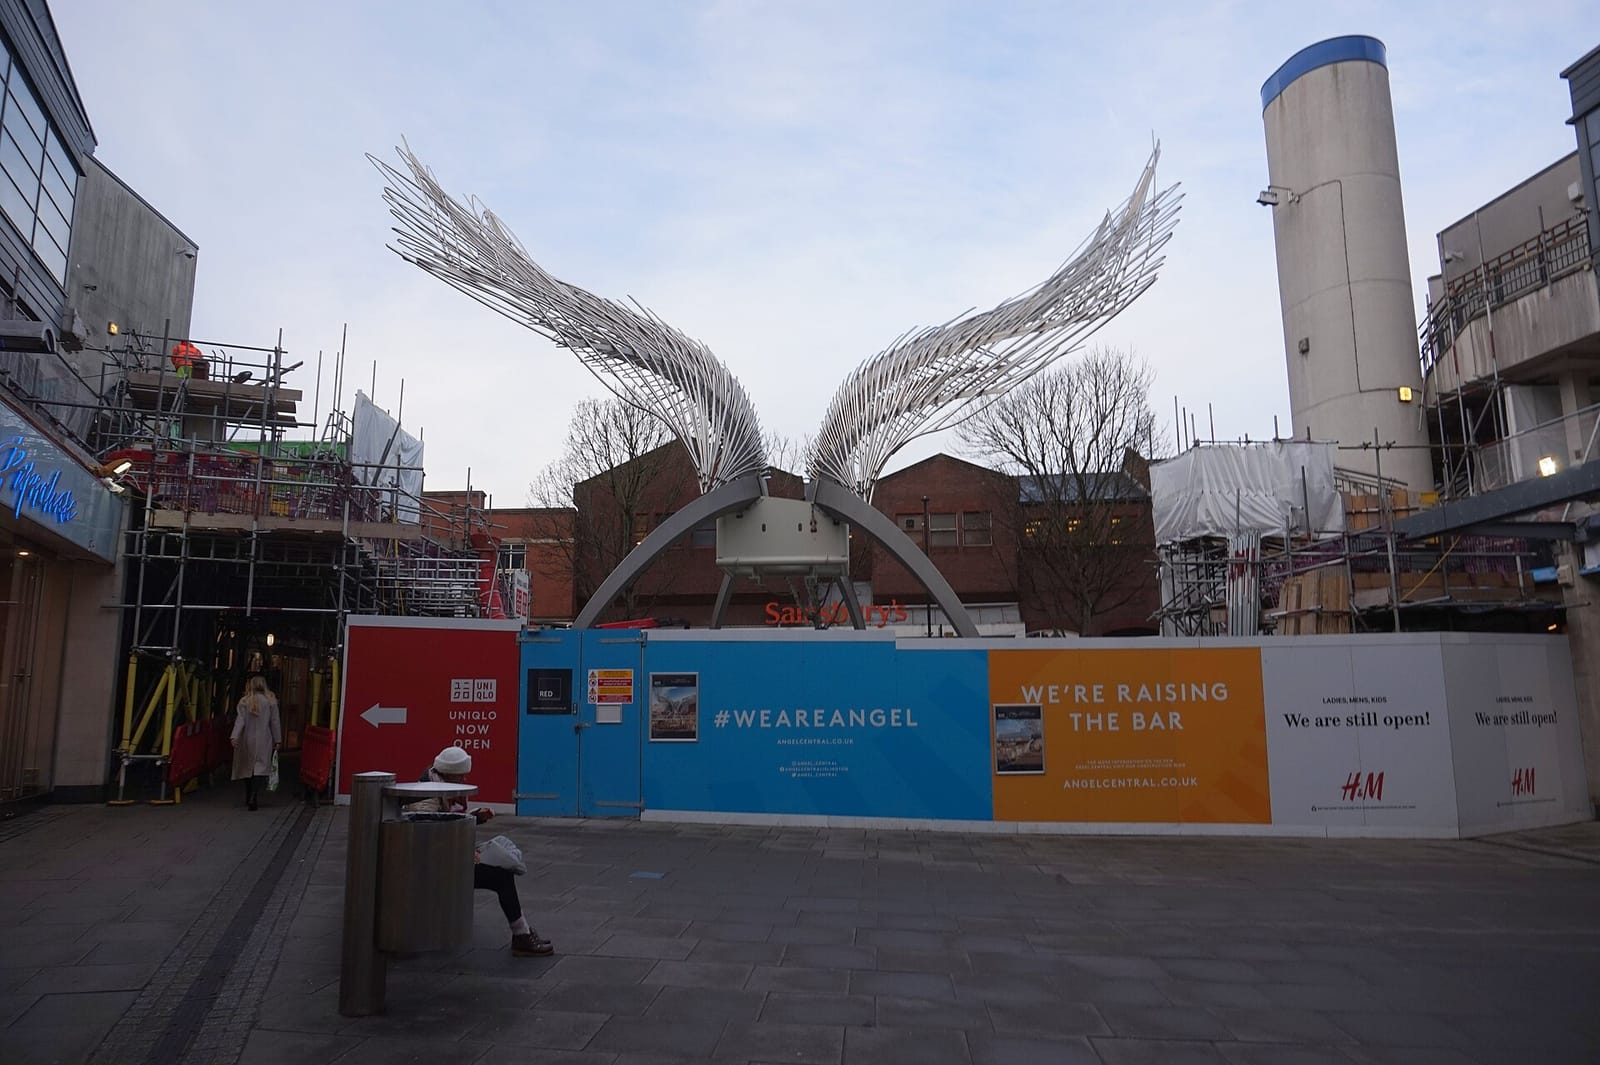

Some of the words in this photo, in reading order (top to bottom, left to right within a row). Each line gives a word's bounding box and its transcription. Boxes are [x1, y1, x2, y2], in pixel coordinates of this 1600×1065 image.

[1021, 684, 1104, 705] WE'RE
[1117, 682, 1229, 703] RAISING
[1322, 697, 1348, 705] LADIES,
[449, 711, 497, 721] UNIQLO
[714, 707, 919, 729] #WEAREANGEL
[1069, 711, 1119, 732] THE
[1131, 711, 1184, 731] BAR
[1284, 713, 1310, 728] We
[1315, 716, 1341, 727] are
[1345, 711, 1378, 727] still
[1383, 711, 1431, 729] open!
[1474, 712, 1491, 726] We
[1493, 714, 1509, 726] are
[1510, 710, 1530, 725] still
[1531, 710, 1558, 728] open!
[455, 725, 490, 735] NOW
[453, 739, 491, 750] OPEN
[1063, 777, 1198, 789] ANGELCENTRAL.CO.UK
[1341, 770, 1385, 801] H&M
[1511, 767, 1536, 796] H&M
